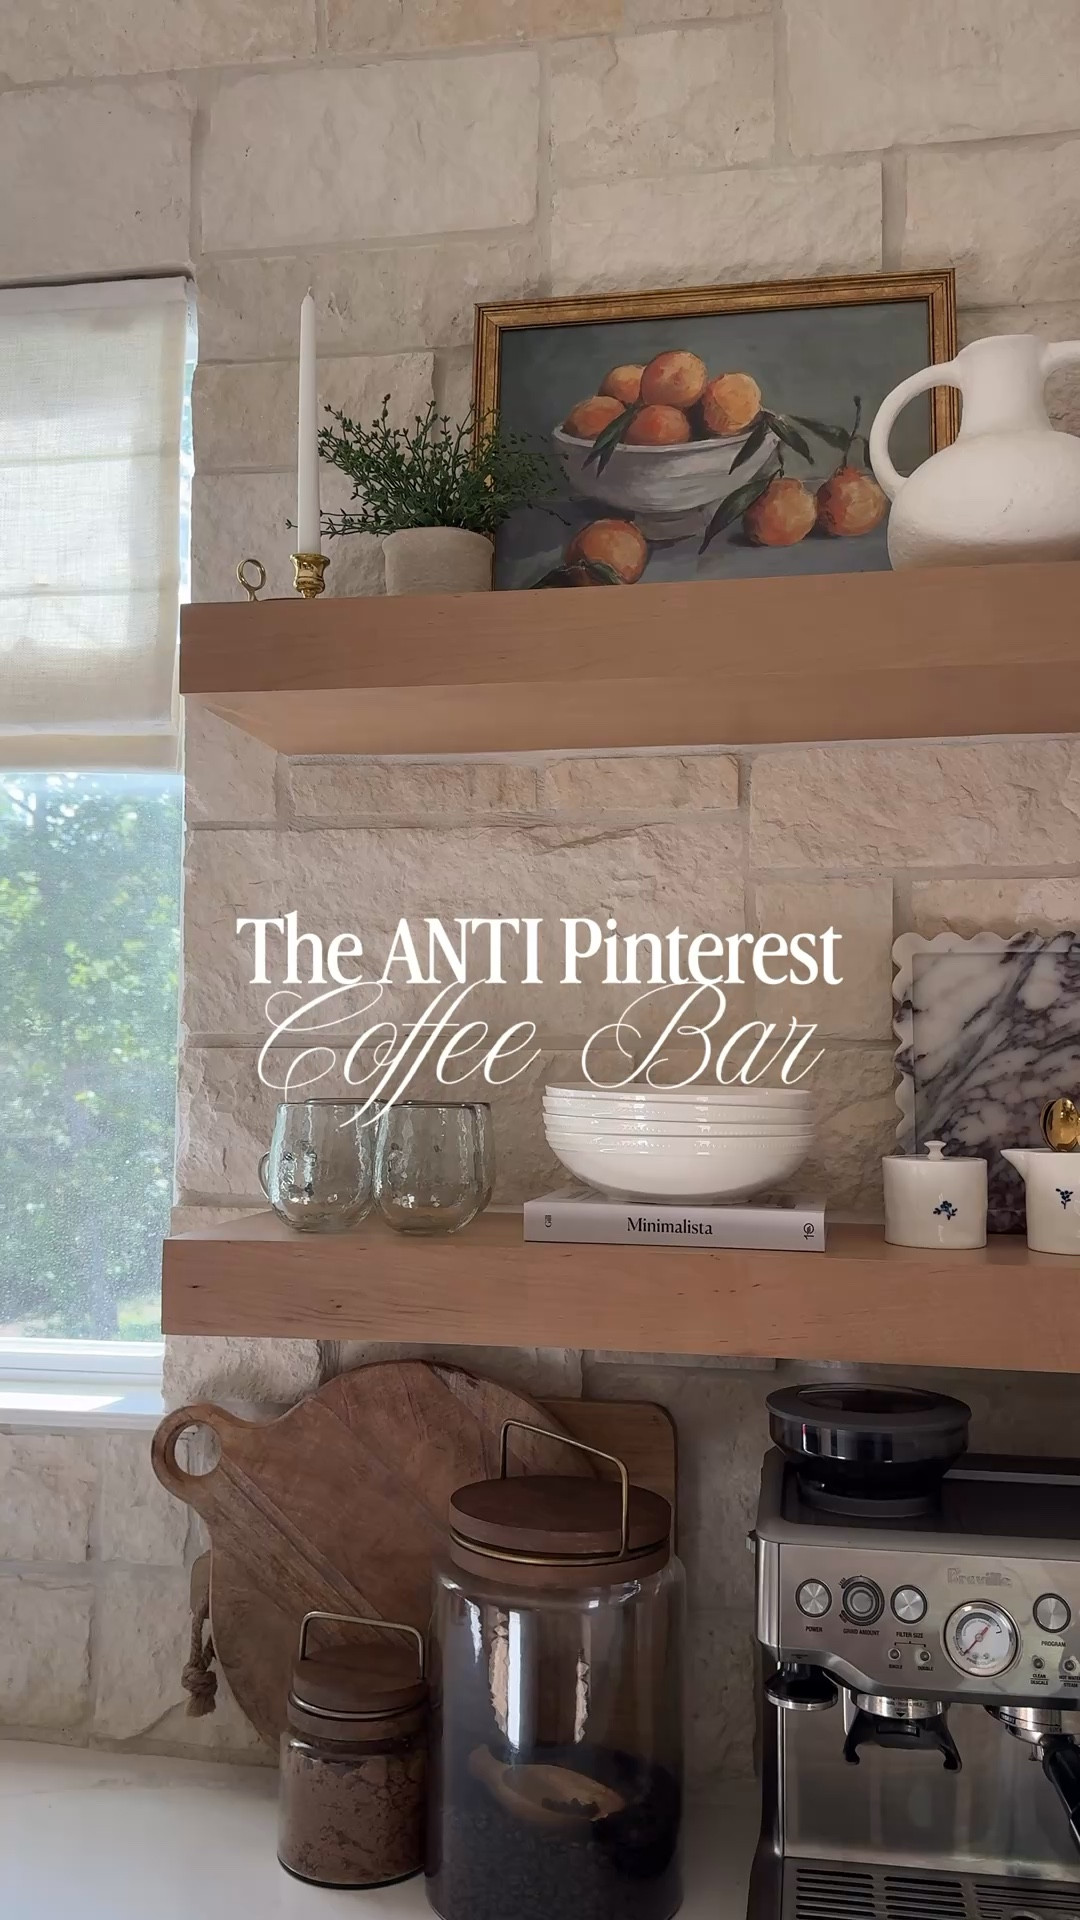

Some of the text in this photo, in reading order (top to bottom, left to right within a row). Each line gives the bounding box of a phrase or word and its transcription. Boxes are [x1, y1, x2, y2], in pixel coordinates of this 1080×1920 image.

[626, 1216, 713, 1236] Minimalista
[805, 1625, 823, 1633] POWER
[1041, 1640, 1067, 1648] PROGRAM
